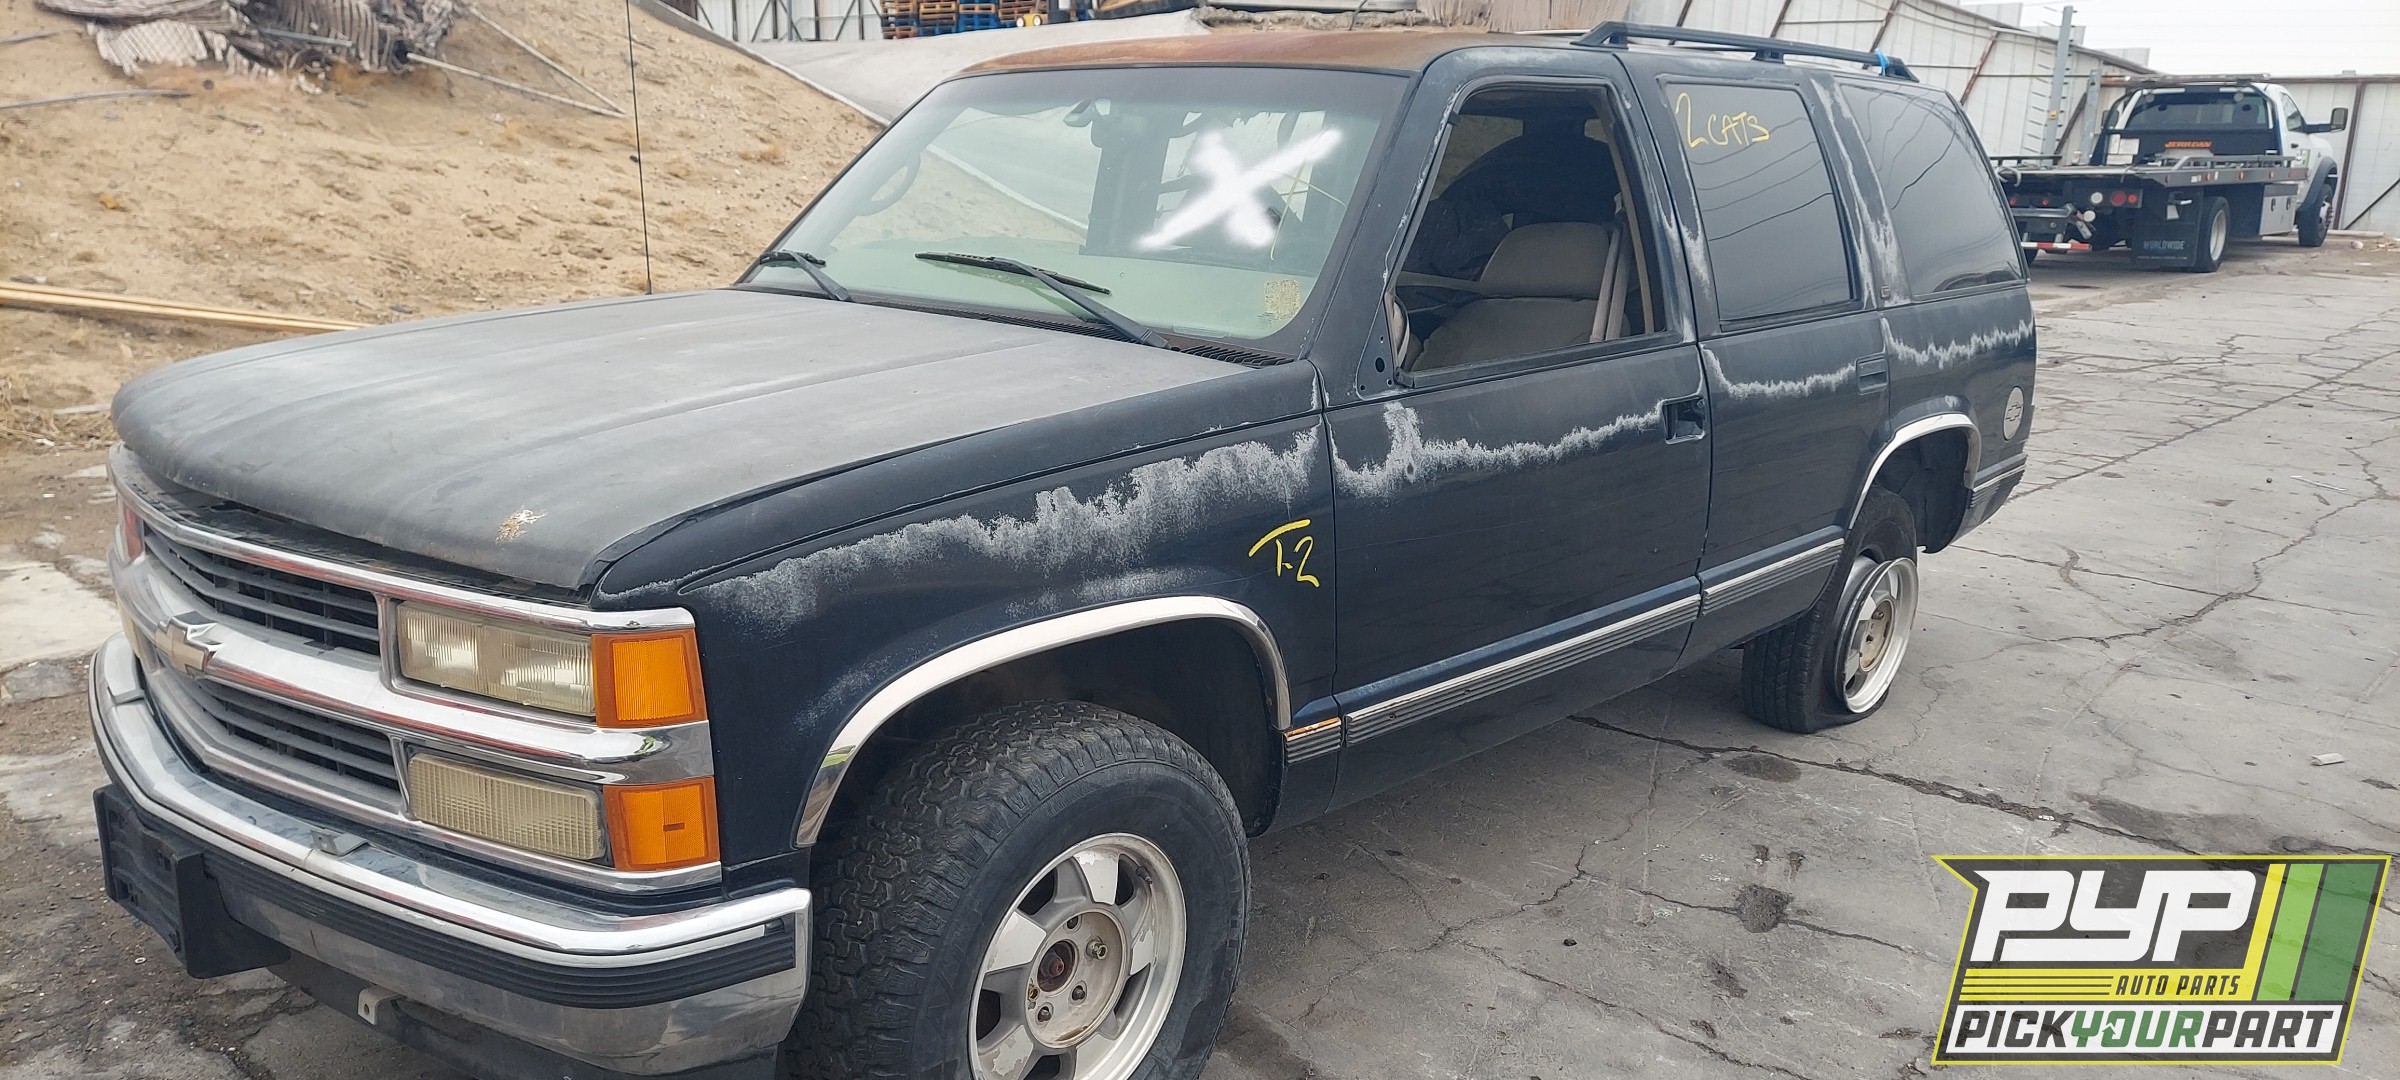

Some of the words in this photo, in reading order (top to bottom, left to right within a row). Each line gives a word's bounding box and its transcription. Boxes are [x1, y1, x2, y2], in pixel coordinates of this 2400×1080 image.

[1675, 92, 1709, 147] 2
[1707, 111, 1770, 145] CATS
[2143, 240, 2186, 250] WORLDWIDE
